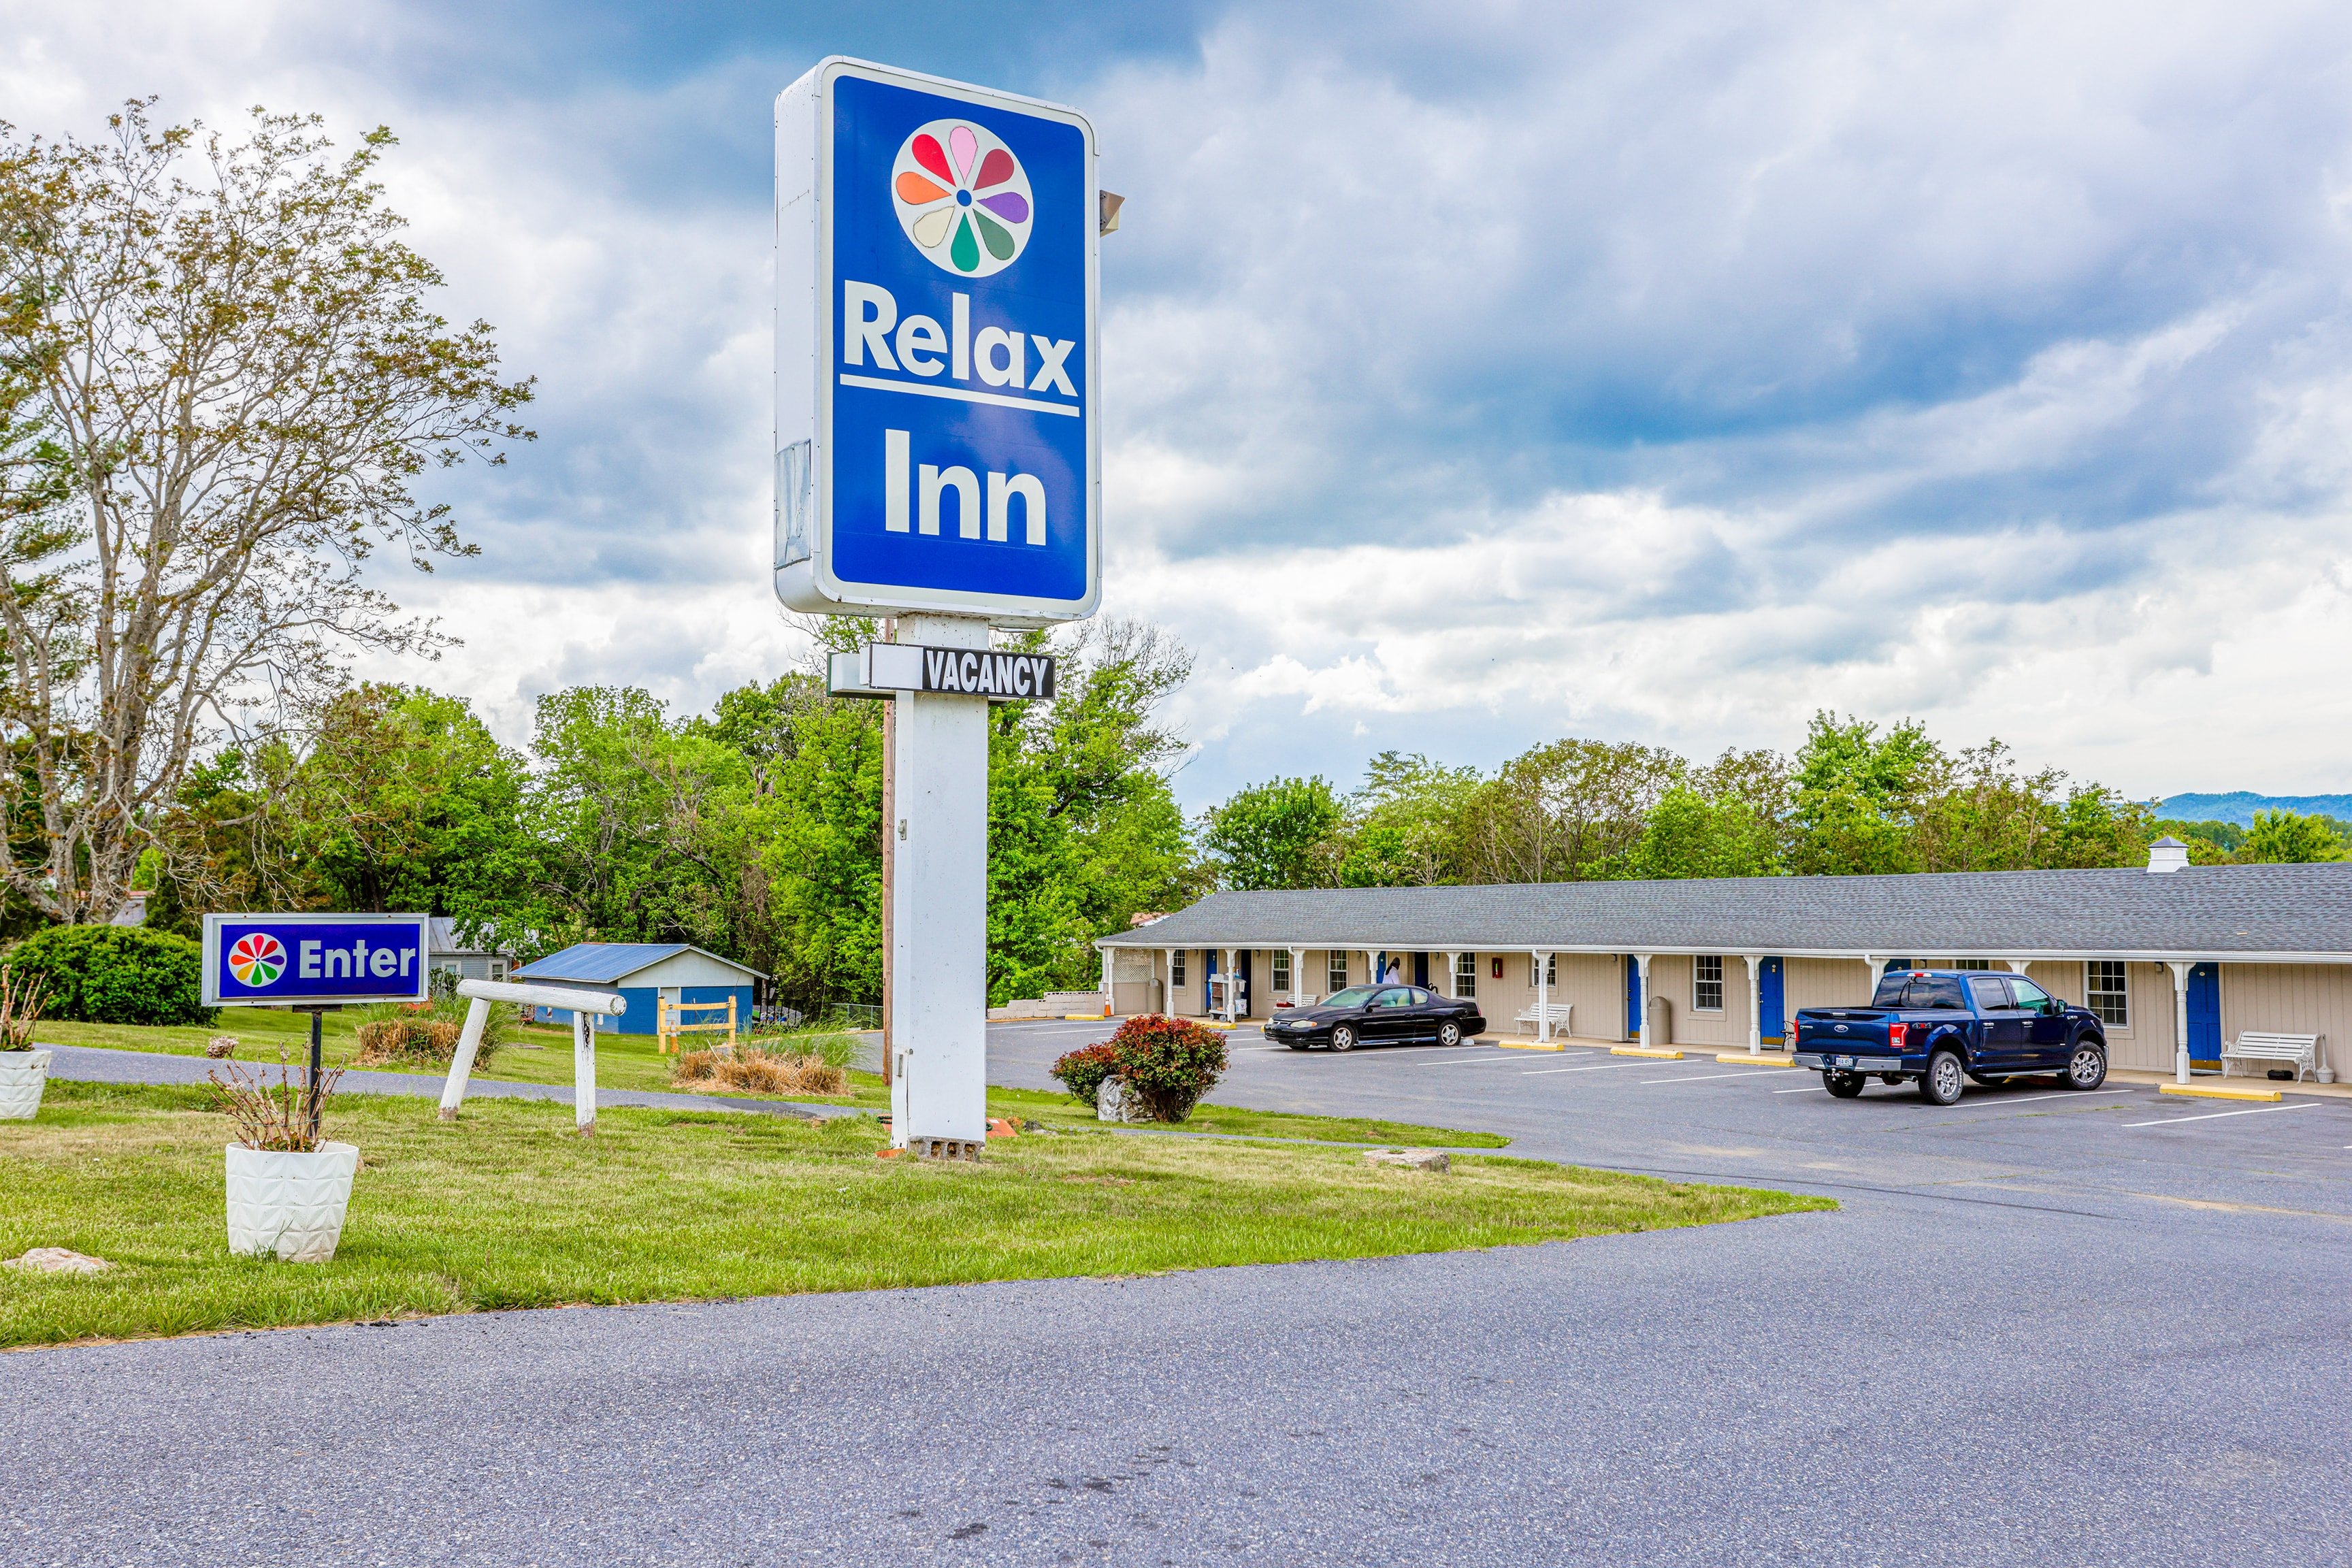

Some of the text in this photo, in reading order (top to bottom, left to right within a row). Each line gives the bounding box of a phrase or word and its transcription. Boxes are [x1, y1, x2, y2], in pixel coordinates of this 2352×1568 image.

[844, 280, 1079, 397] Relax
[885, 429, 1047, 546] Inn
[926, 650, 1048, 696] VACANCY
[299, 939, 416, 979] Enter
